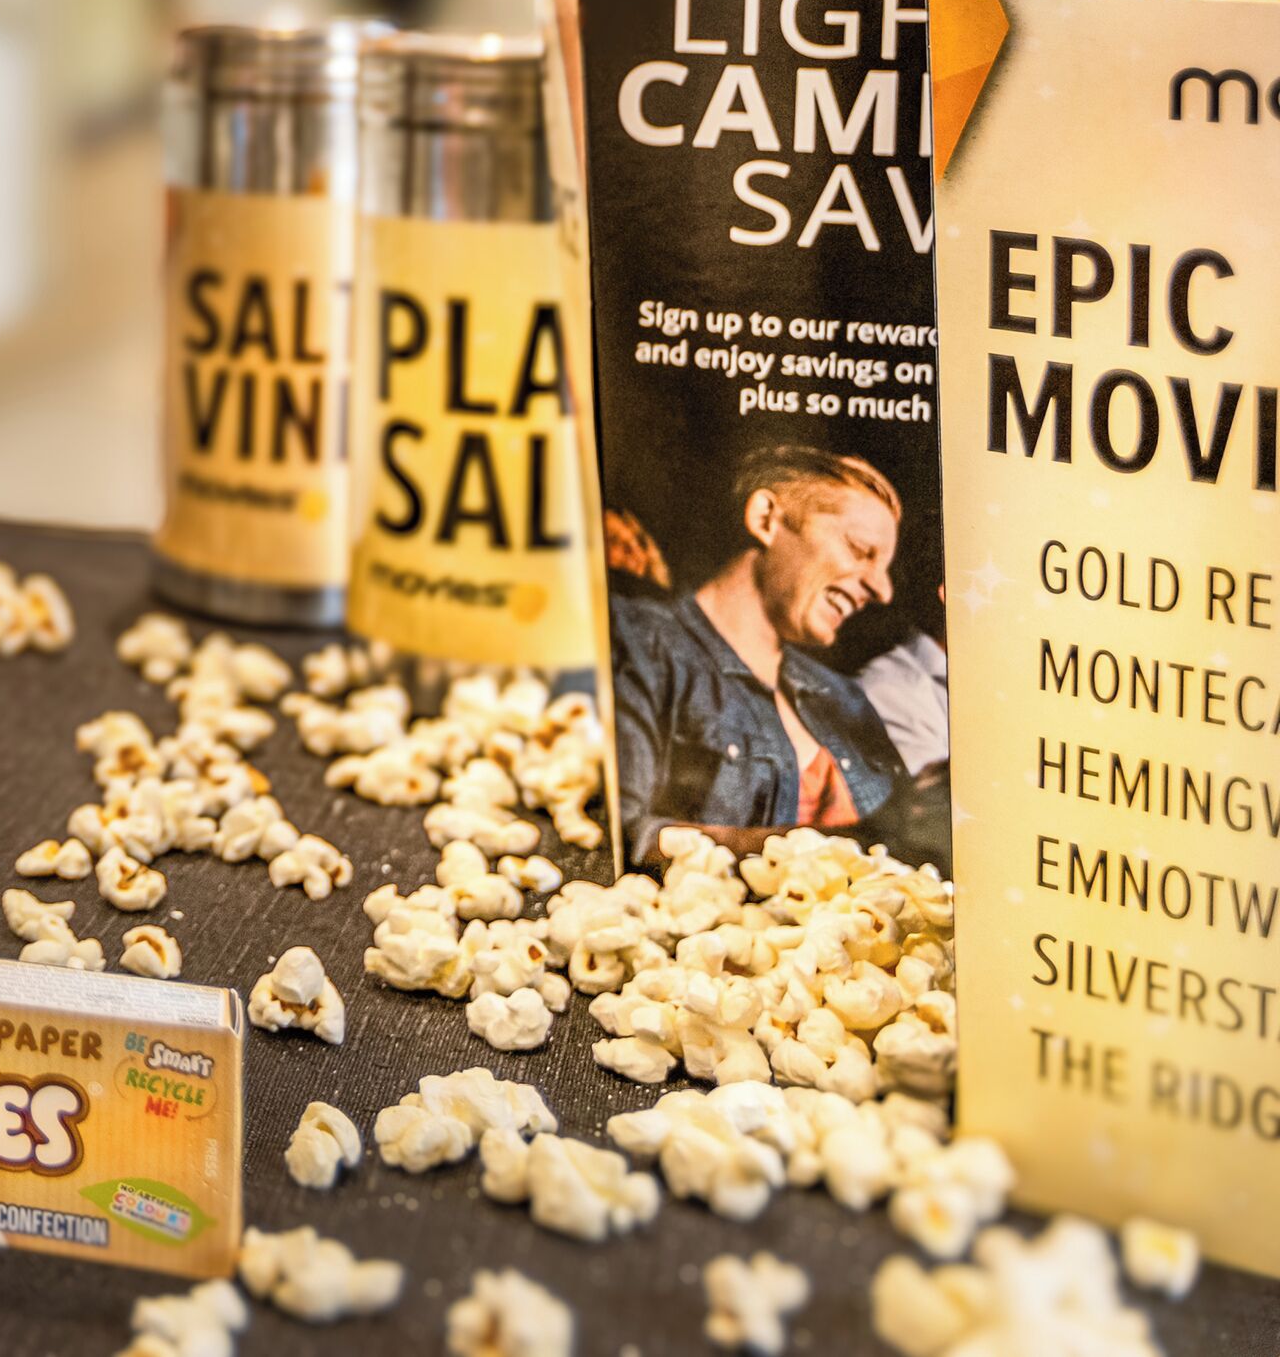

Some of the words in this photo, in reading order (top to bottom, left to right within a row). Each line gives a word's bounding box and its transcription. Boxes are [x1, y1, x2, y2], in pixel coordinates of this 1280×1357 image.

[617, 60, 932, 156] CAM
[639, 300, 698, 336] Sign
[706, 312, 742, 341] up
[749, 312, 782, 339] to
[789, 315, 839, 341] our
[988, 229, 1235, 356] EPIC
[378, 288, 576, 418] PLA
[635, 341, 687, 367] and
[695, 345, 774, 379] enjoy
[782, 352, 888, 389] savings
[894, 363, 933, 385] on
[184, 360, 348, 464] VIN
[739, 384, 798, 415] plus
[806, 393, 840, 417] so
[848, 390, 932, 423] much
[987, 353, 1279, 493] MOVI
[374, 418, 571, 550] SAL
[1039, 539, 1181, 613] GOLD
[1205, 565, 1272, 630] RE
[1037, 834, 1279, 939] EMNOTW
[1032, 932, 1279, 1040] SILVERST
[0, 1016, 104, 1061] PAPER
[124, 1032, 147, 1054] BE
[1032, 1028, 1128, 1104] THE
[125, 1067, 206, 1106] RECYCLE
[144, 1095, 180, 1119] ME!
[120, 1185, 135, 1194] NO
